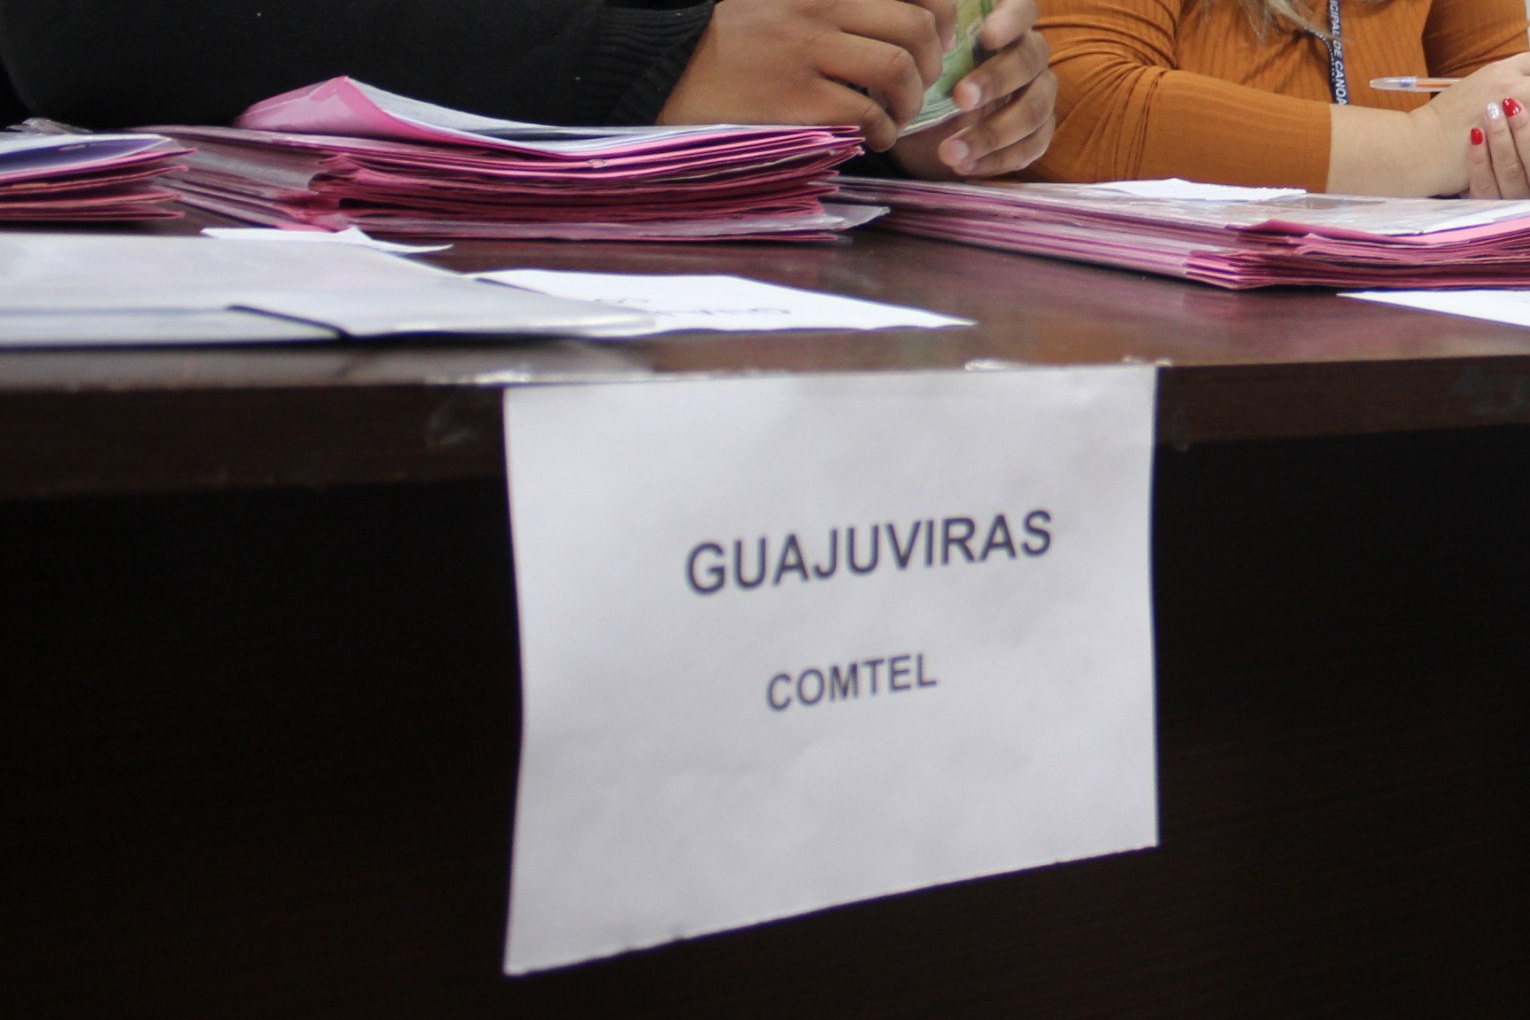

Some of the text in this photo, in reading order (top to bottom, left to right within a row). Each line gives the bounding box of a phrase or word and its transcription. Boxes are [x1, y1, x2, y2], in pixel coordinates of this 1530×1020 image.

[1335, 60, 1348, 105] CANOA
[686, 509, 1052, 596] GUAJUVIRAS
[766, 652, 938, 711] COMTEL
